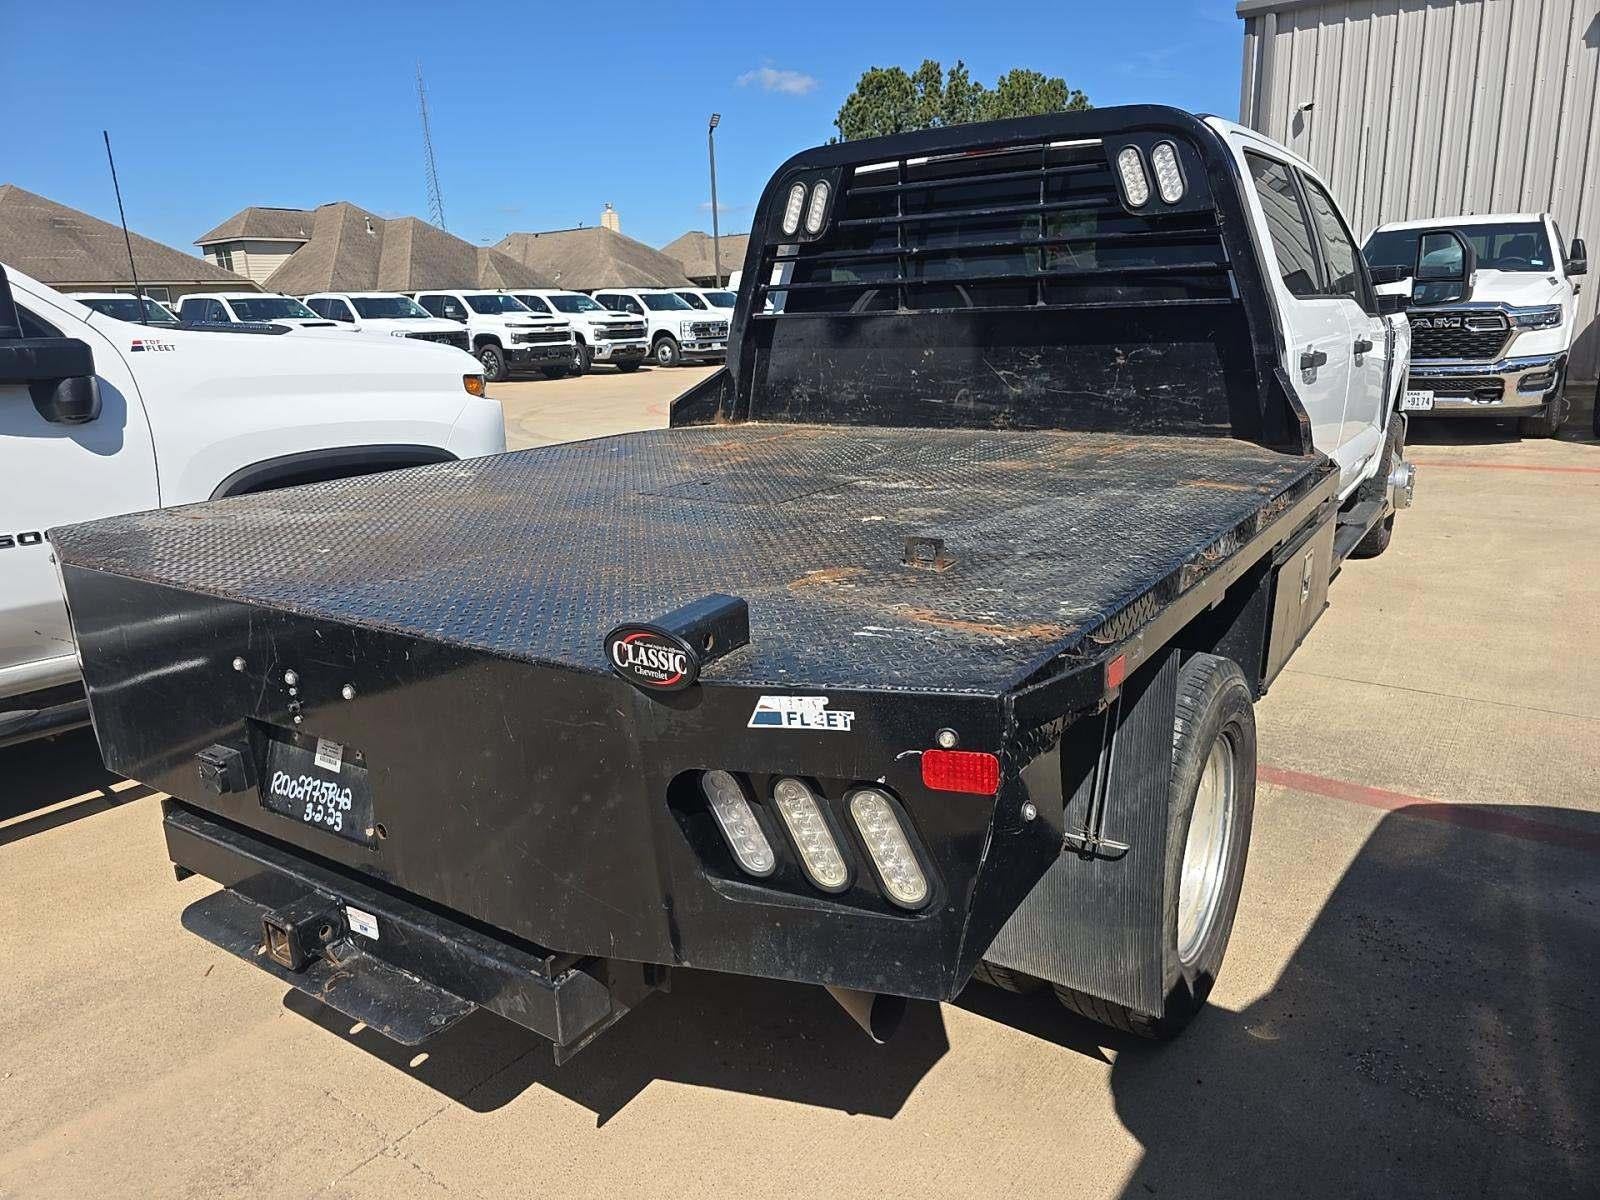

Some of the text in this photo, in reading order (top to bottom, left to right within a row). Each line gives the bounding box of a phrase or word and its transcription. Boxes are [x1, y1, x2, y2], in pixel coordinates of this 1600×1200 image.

[1410, 317, 1461, 329] AM
[145, 344, 176, 352] FLEET
[612, 640, 687, 675] CLASSIC
[634, 665, 668, 680] Chevrolet
